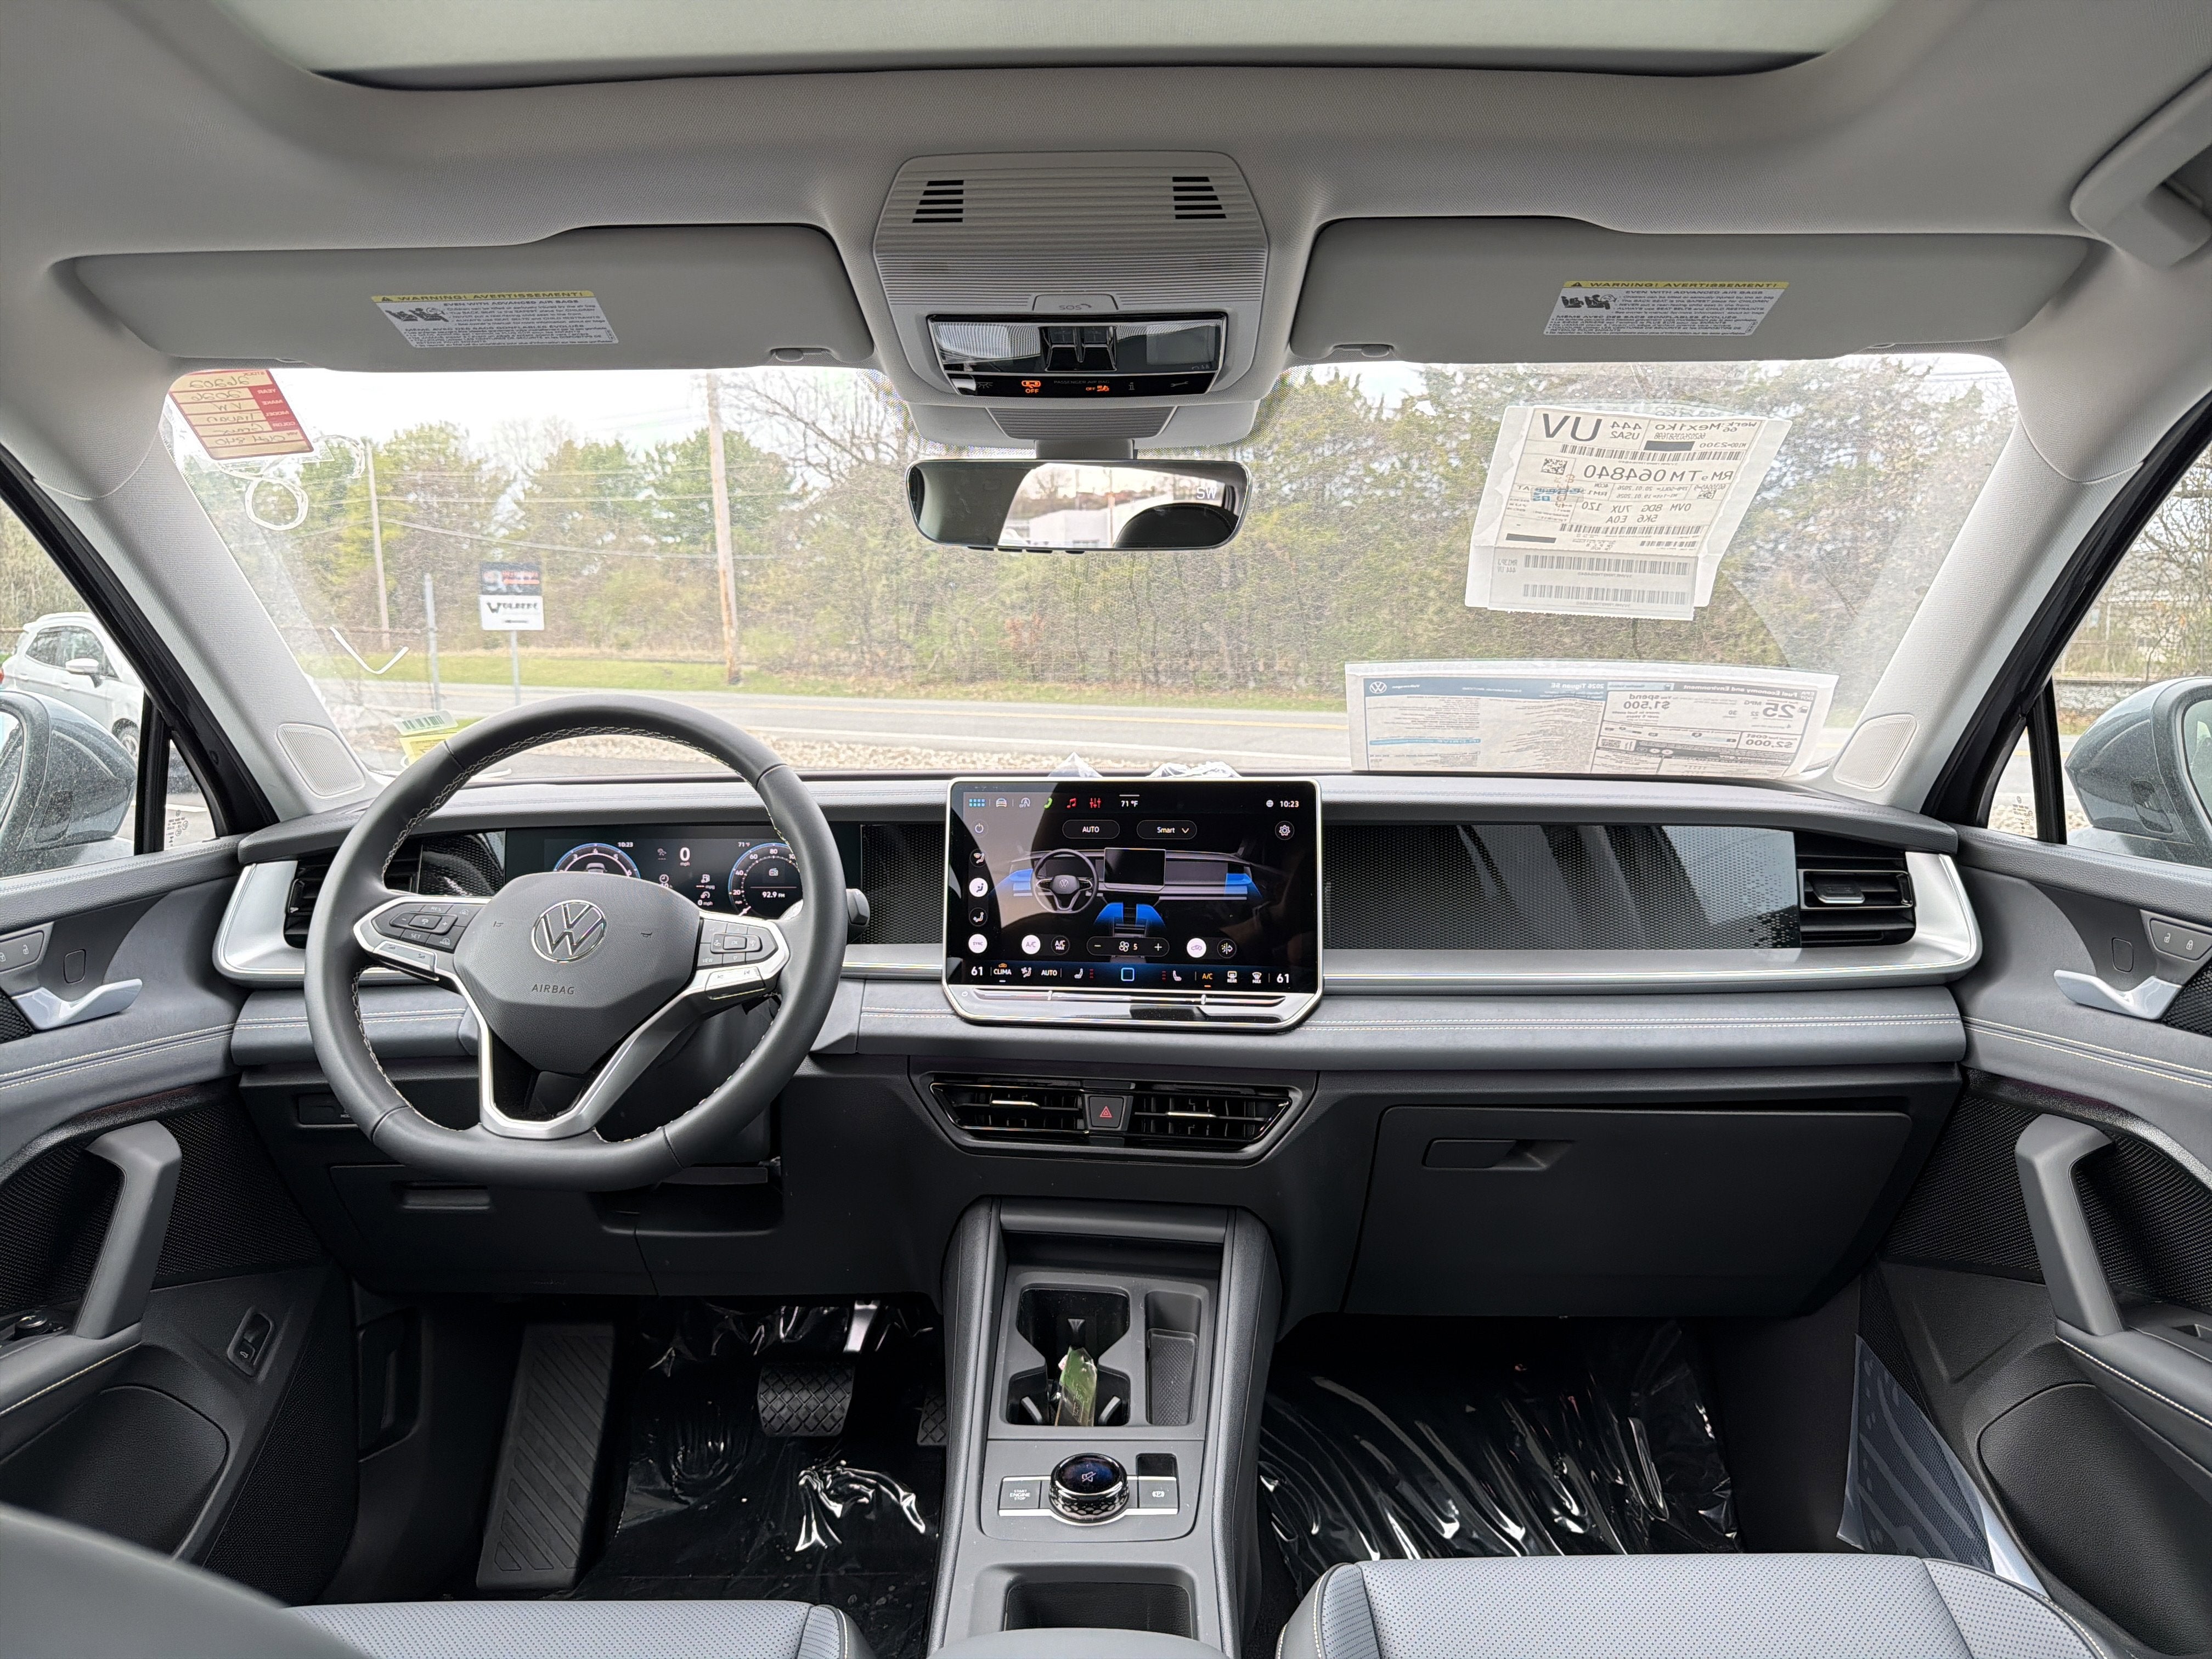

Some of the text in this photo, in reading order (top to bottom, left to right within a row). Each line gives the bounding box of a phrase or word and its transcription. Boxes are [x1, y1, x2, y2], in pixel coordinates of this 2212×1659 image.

[1197, 487, 1218, 499] SW
[680, 847, 691, 861] 0
[531, 899, 607, 963] VW
[970, 966, 983, 976] 61
[1276, 973, 1289, 983] 61
[531, 984, 575, 995] AIRBAG
